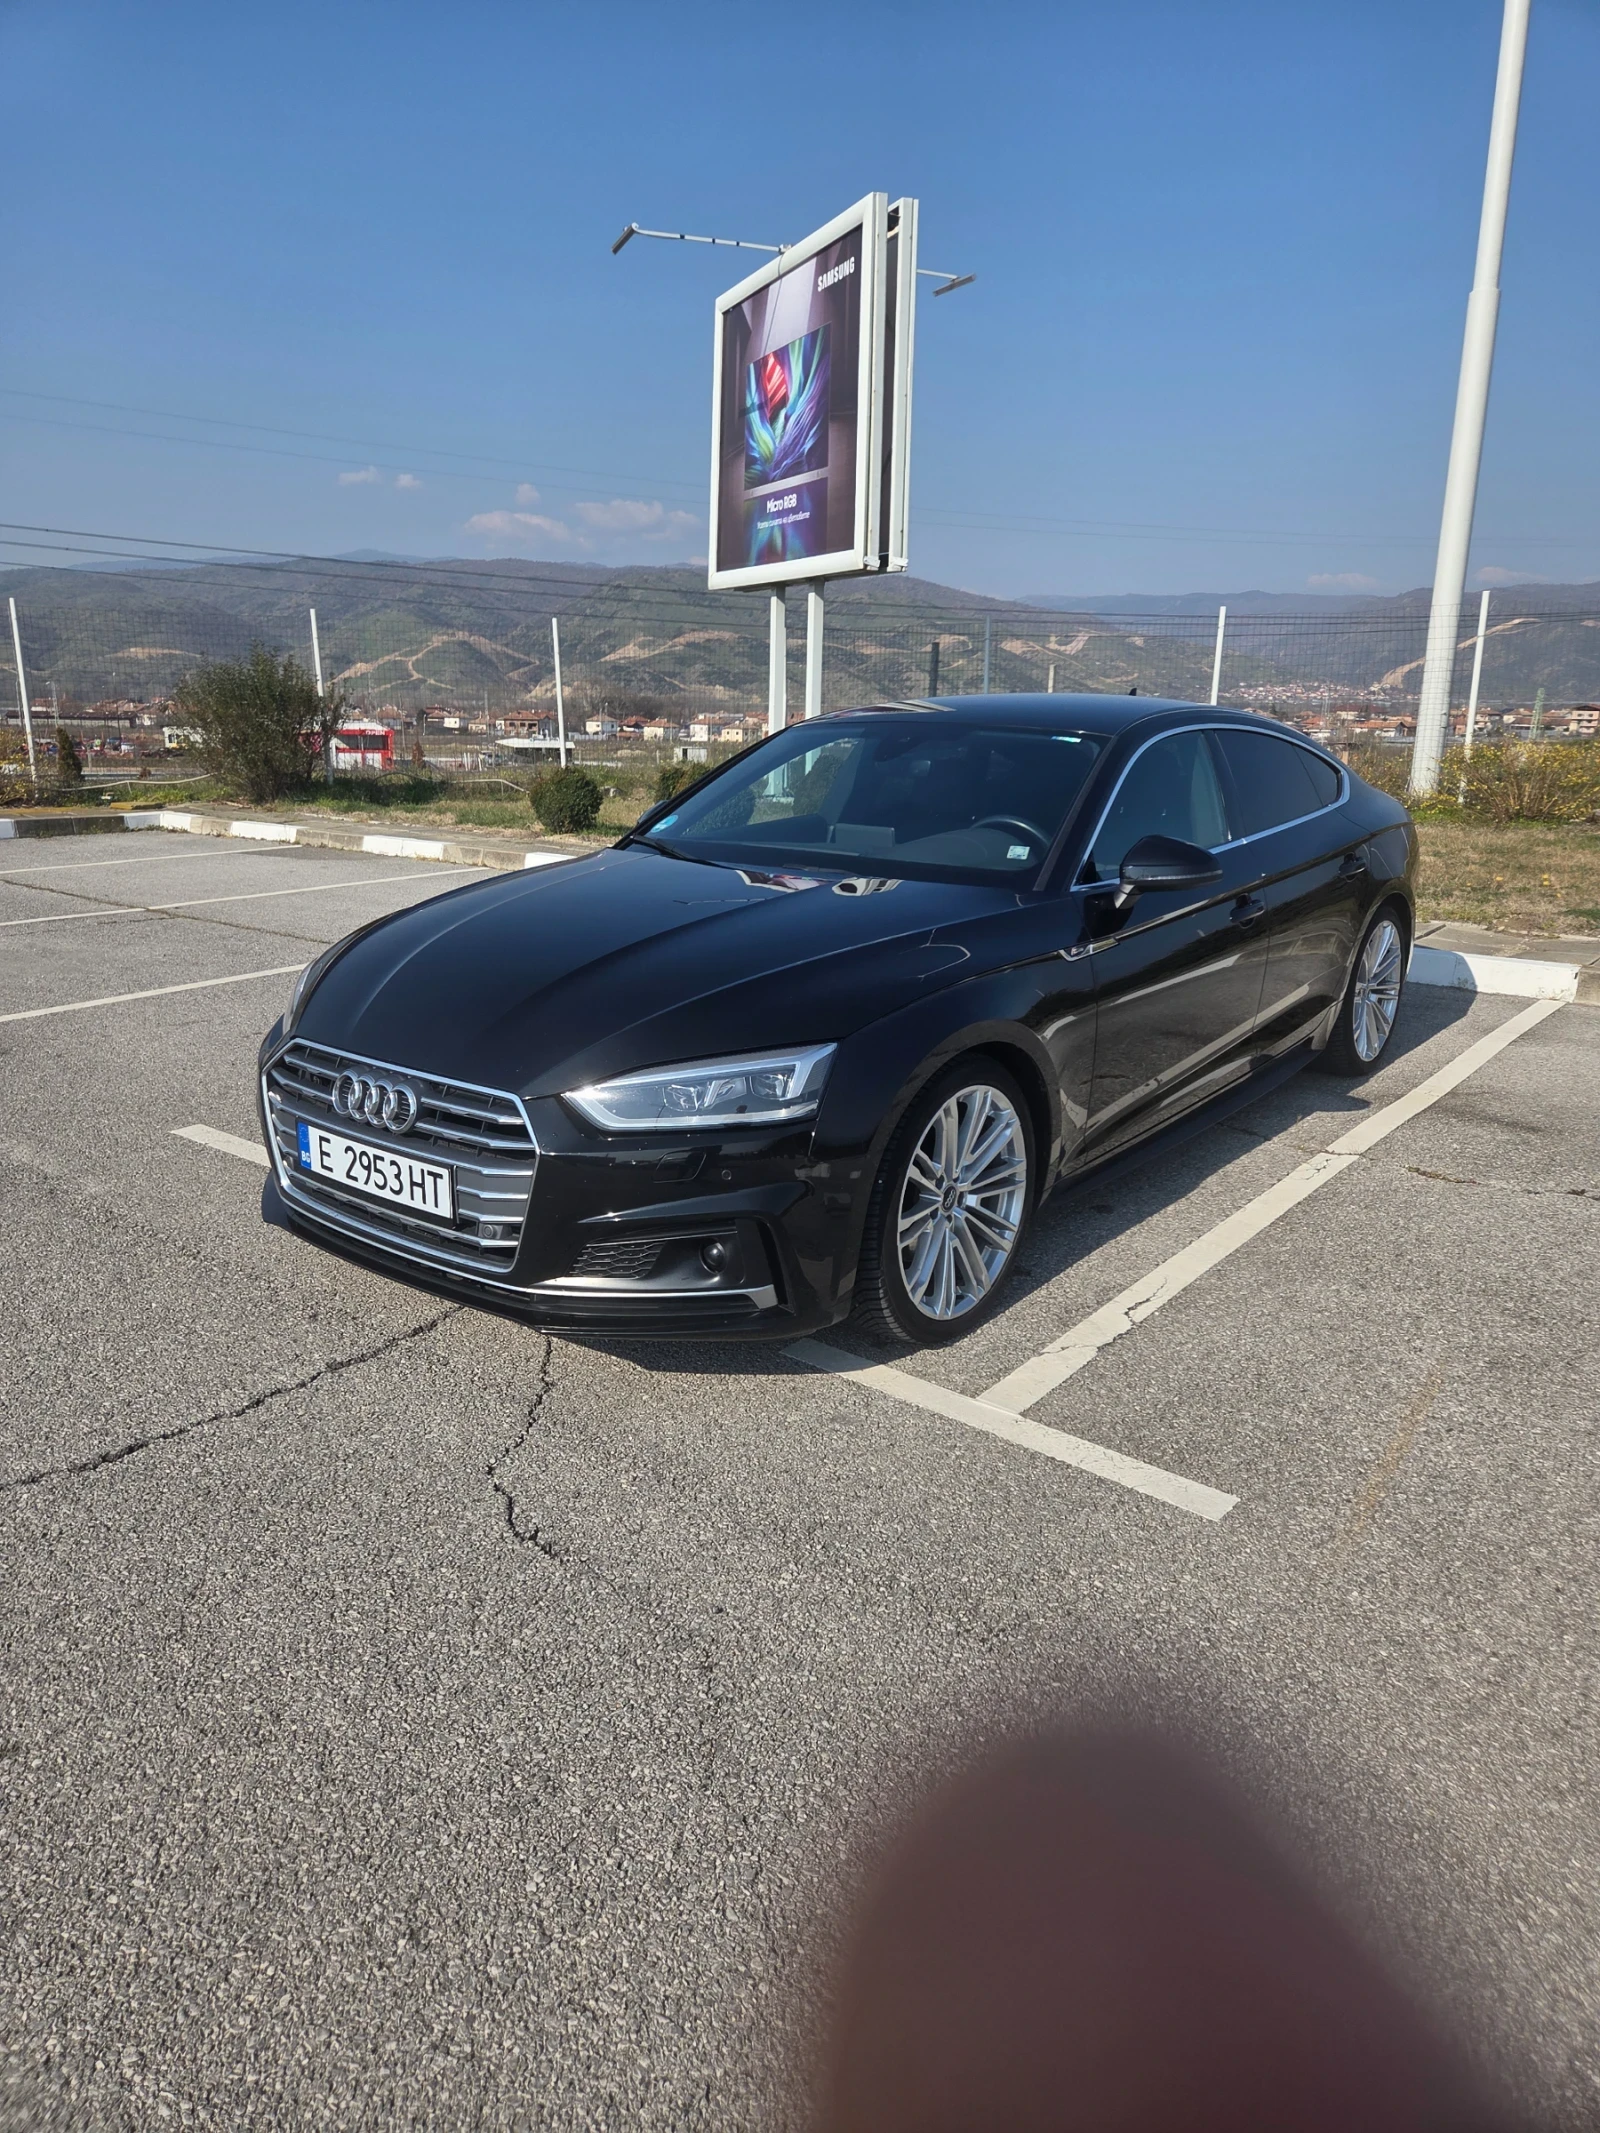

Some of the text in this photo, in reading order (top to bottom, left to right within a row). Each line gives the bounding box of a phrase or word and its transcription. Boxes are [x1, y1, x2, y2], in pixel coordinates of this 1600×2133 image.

[817, 256, 855, 292] SAMSUNG
[766, 493, 797, 513] Micro RGB
[301, 1151, 311, 1163] BG
[318, 1134, 444, 1209] E 2953 HT
